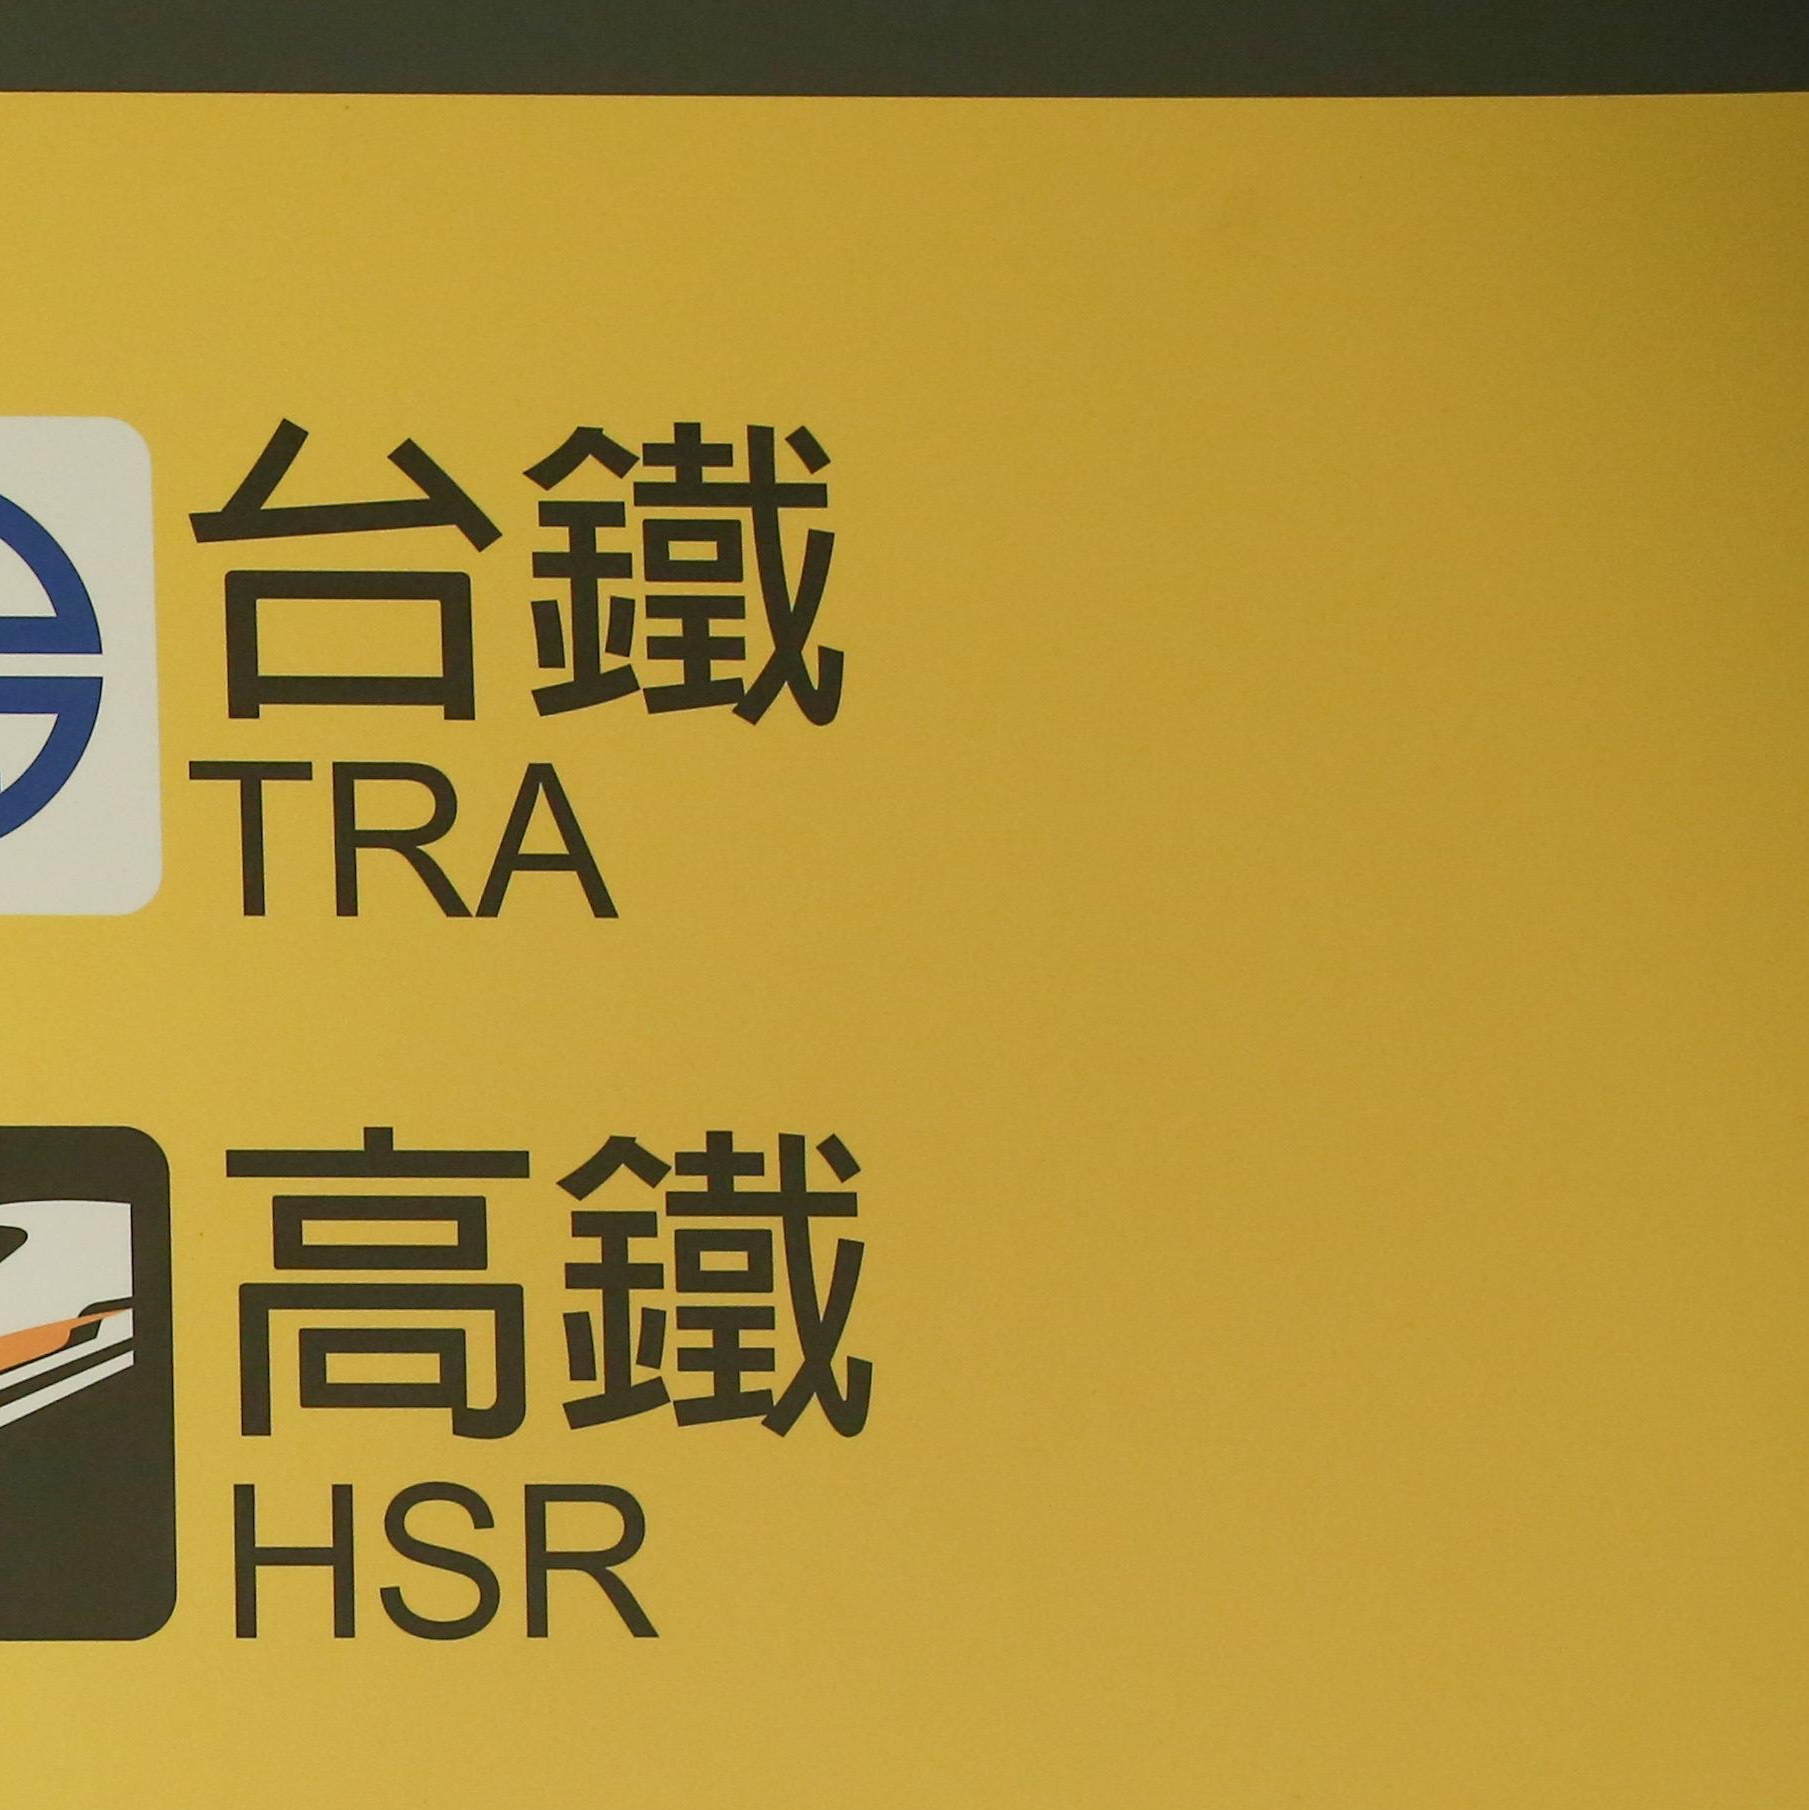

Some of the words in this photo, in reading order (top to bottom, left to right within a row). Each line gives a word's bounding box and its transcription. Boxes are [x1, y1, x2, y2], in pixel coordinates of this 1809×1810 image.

[189, 418, 844, 726] 台鐵
[189, 761, 618, 918] TRA
[226, 1127, 872, 1439] 高鐵
[234, 1482, 659, 1640] HSR
